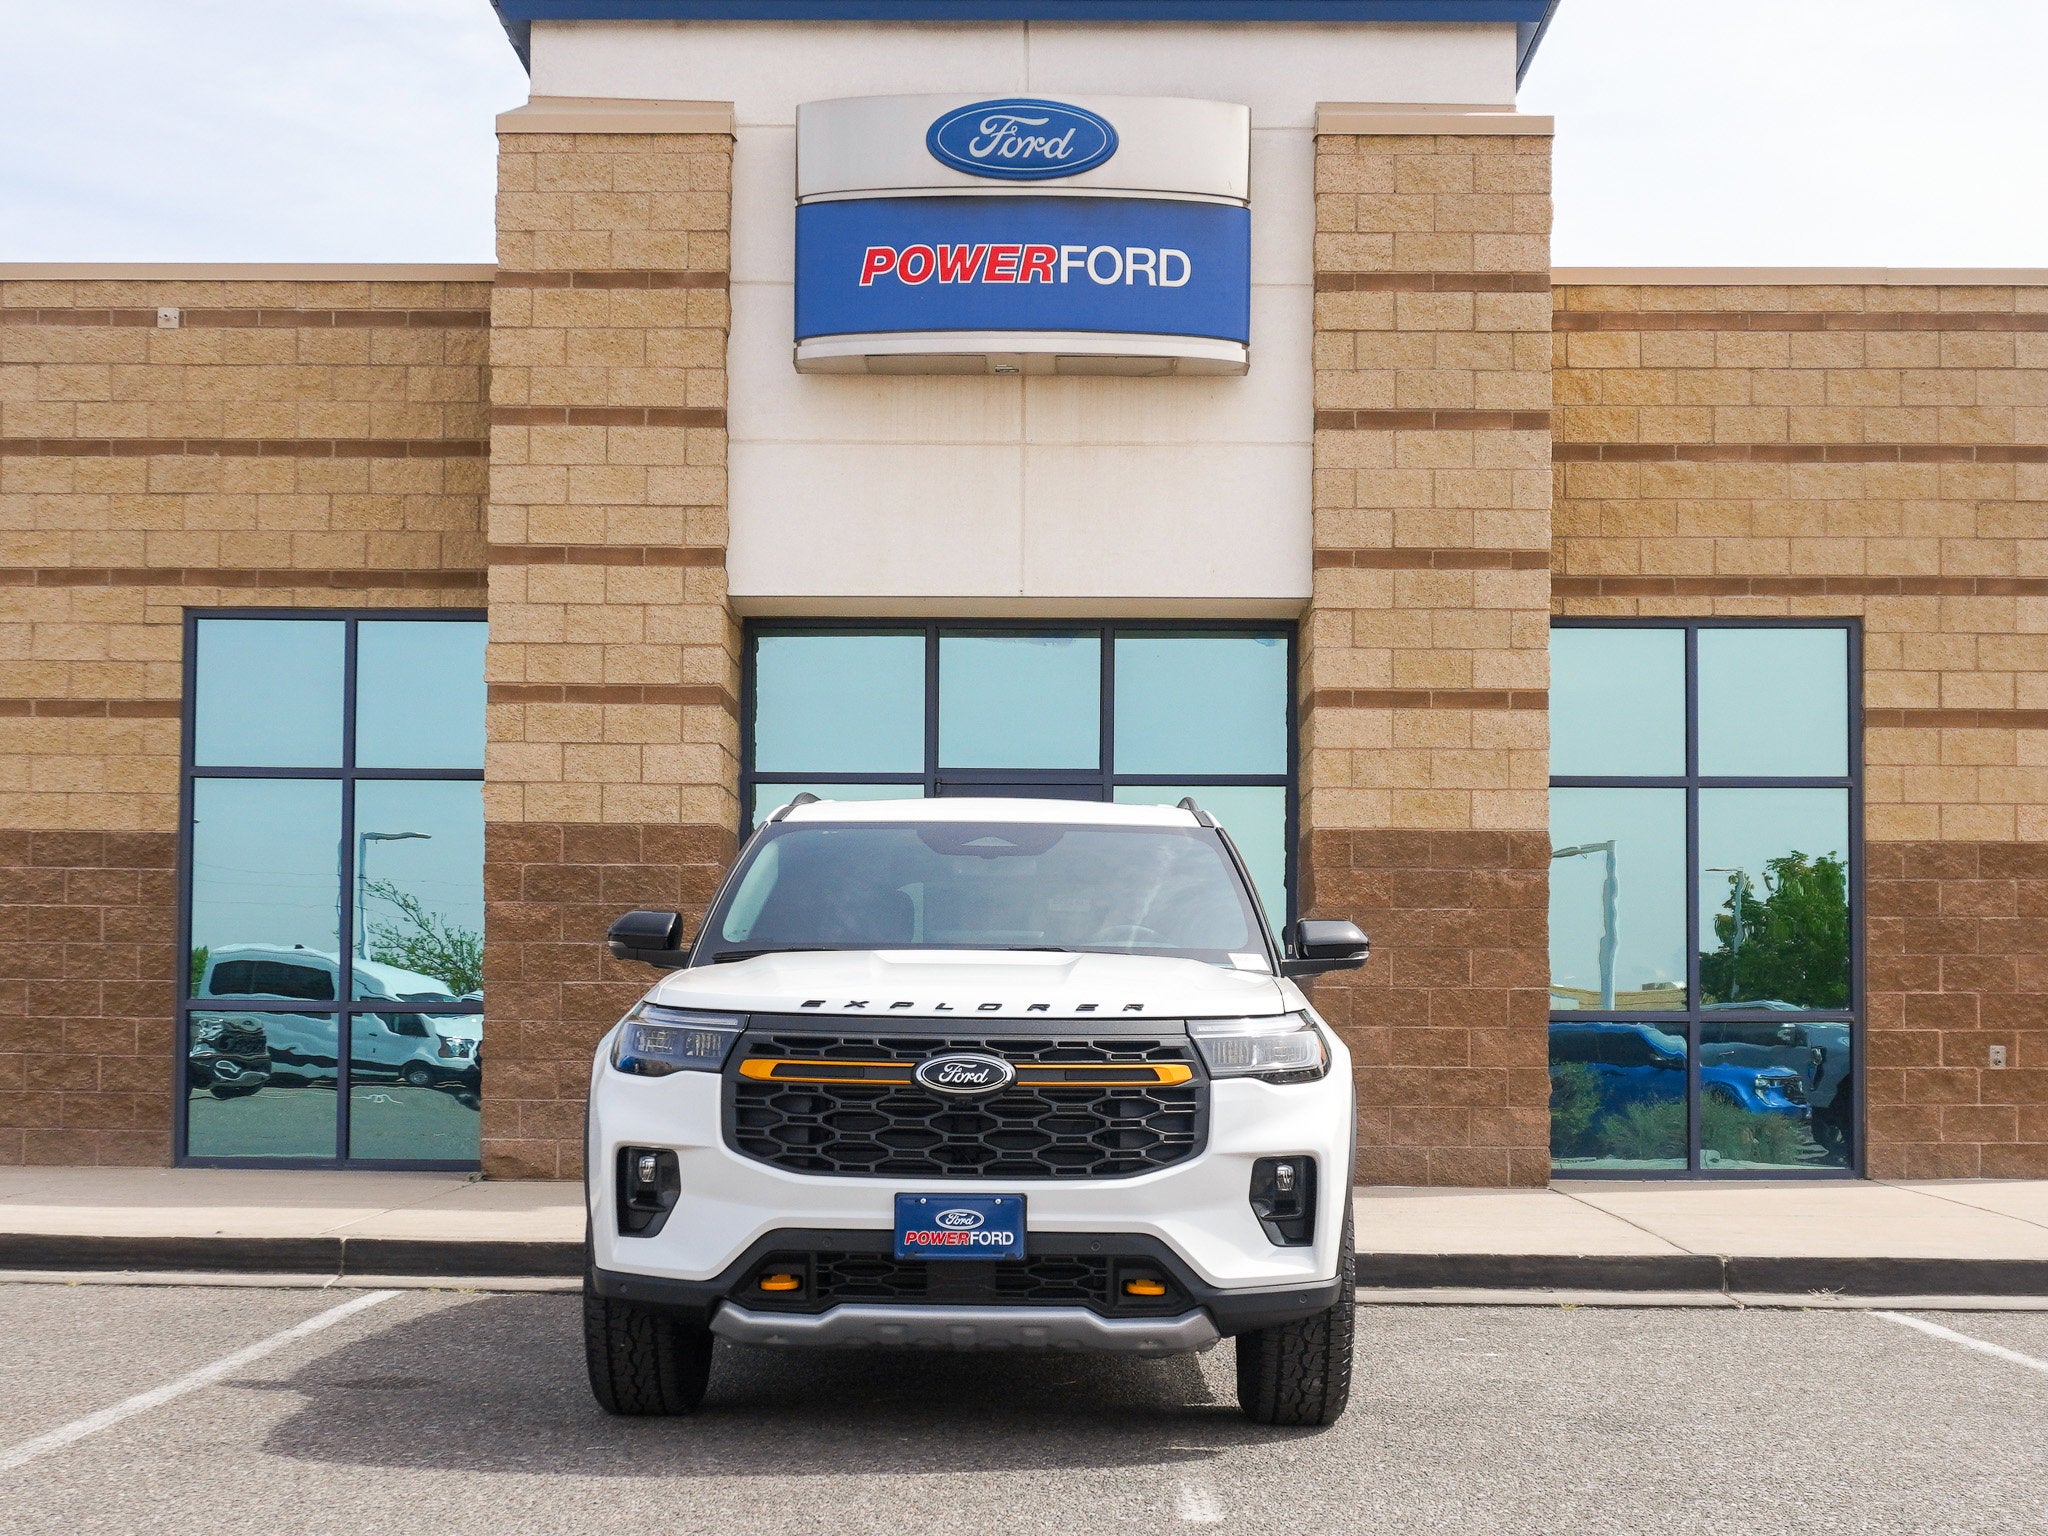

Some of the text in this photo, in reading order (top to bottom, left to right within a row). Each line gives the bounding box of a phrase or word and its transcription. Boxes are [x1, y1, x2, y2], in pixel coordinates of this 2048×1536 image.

[969, 115, 1077, 160] Ford
[801, 999, 1145, 1012] EXPLORER
[938, 1062, 990, 1084] Ford
[945, 1212, 974, 1226] Ford
